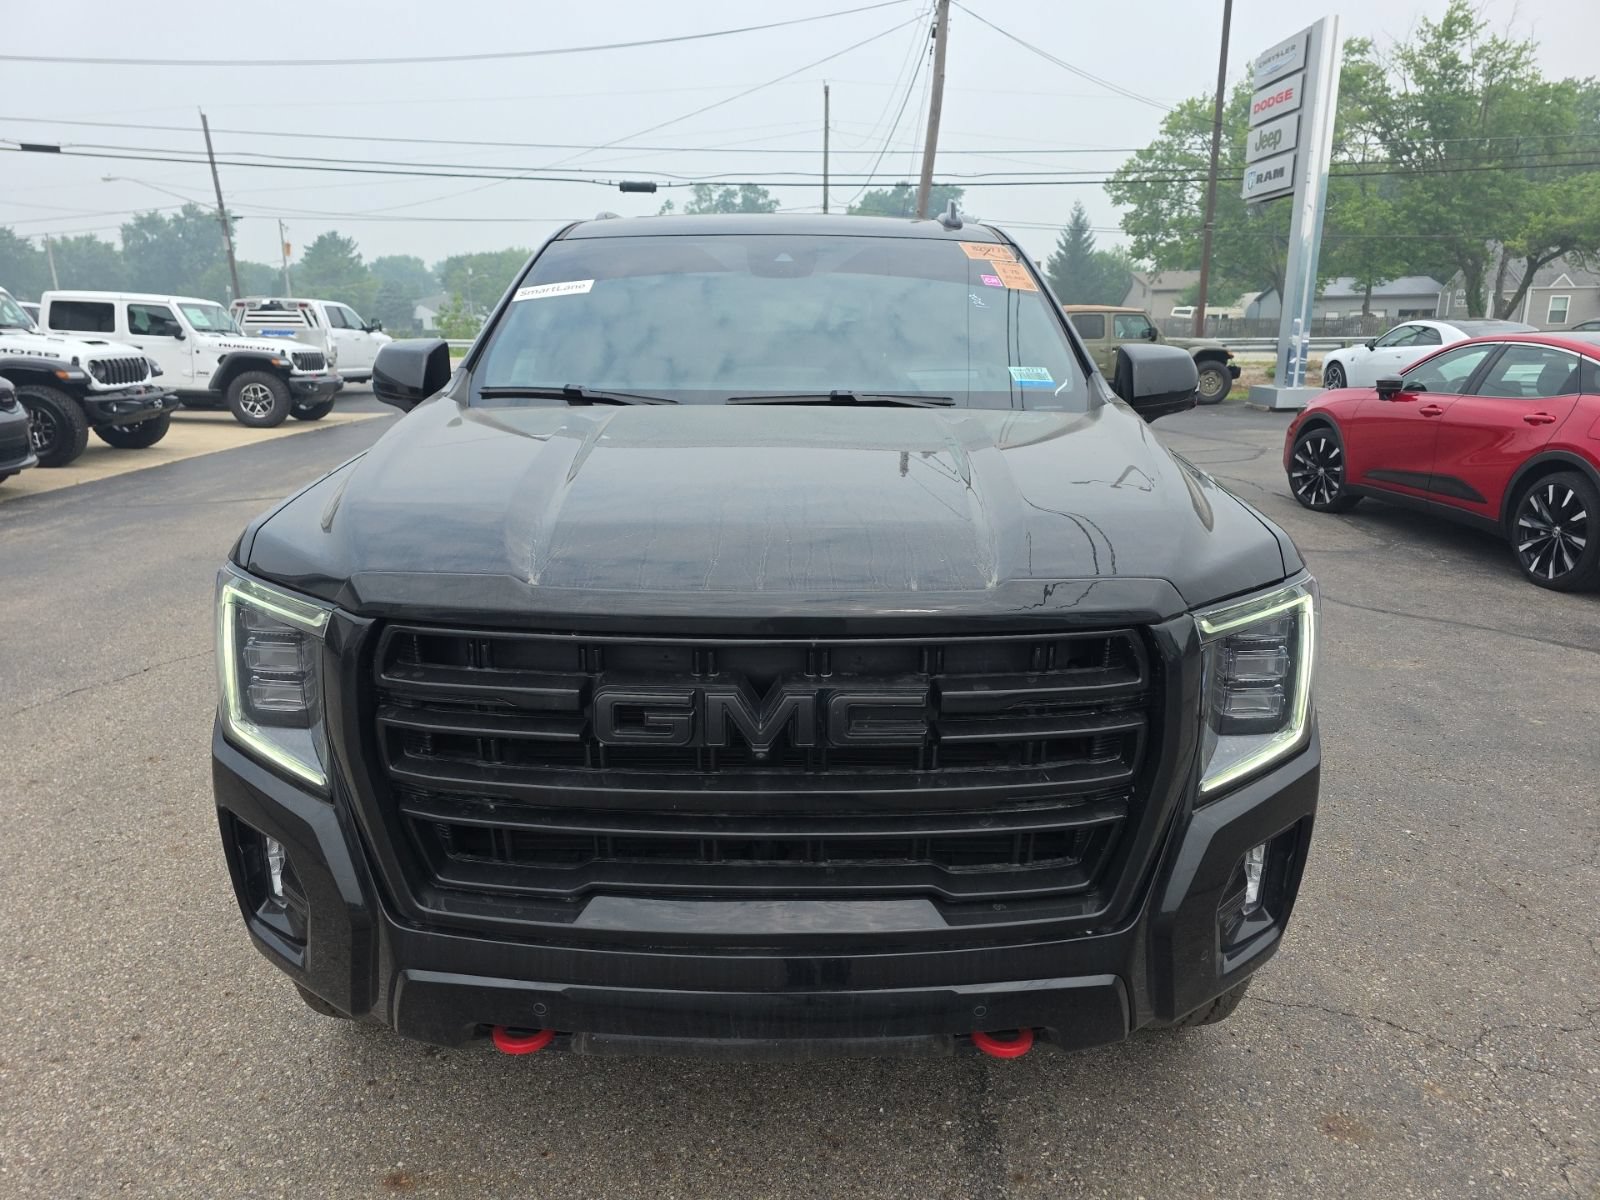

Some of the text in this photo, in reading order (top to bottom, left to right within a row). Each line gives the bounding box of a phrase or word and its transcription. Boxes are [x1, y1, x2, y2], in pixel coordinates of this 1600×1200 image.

[1258, 44, 1297, 68] CHRYSLER
[1253, 88, 1294, 115] DODGE
[1255, 128, 1282, 152] Jeep
[1255, 166, 1285, 185] RAM
[592, 684, 929, 751] GMC
